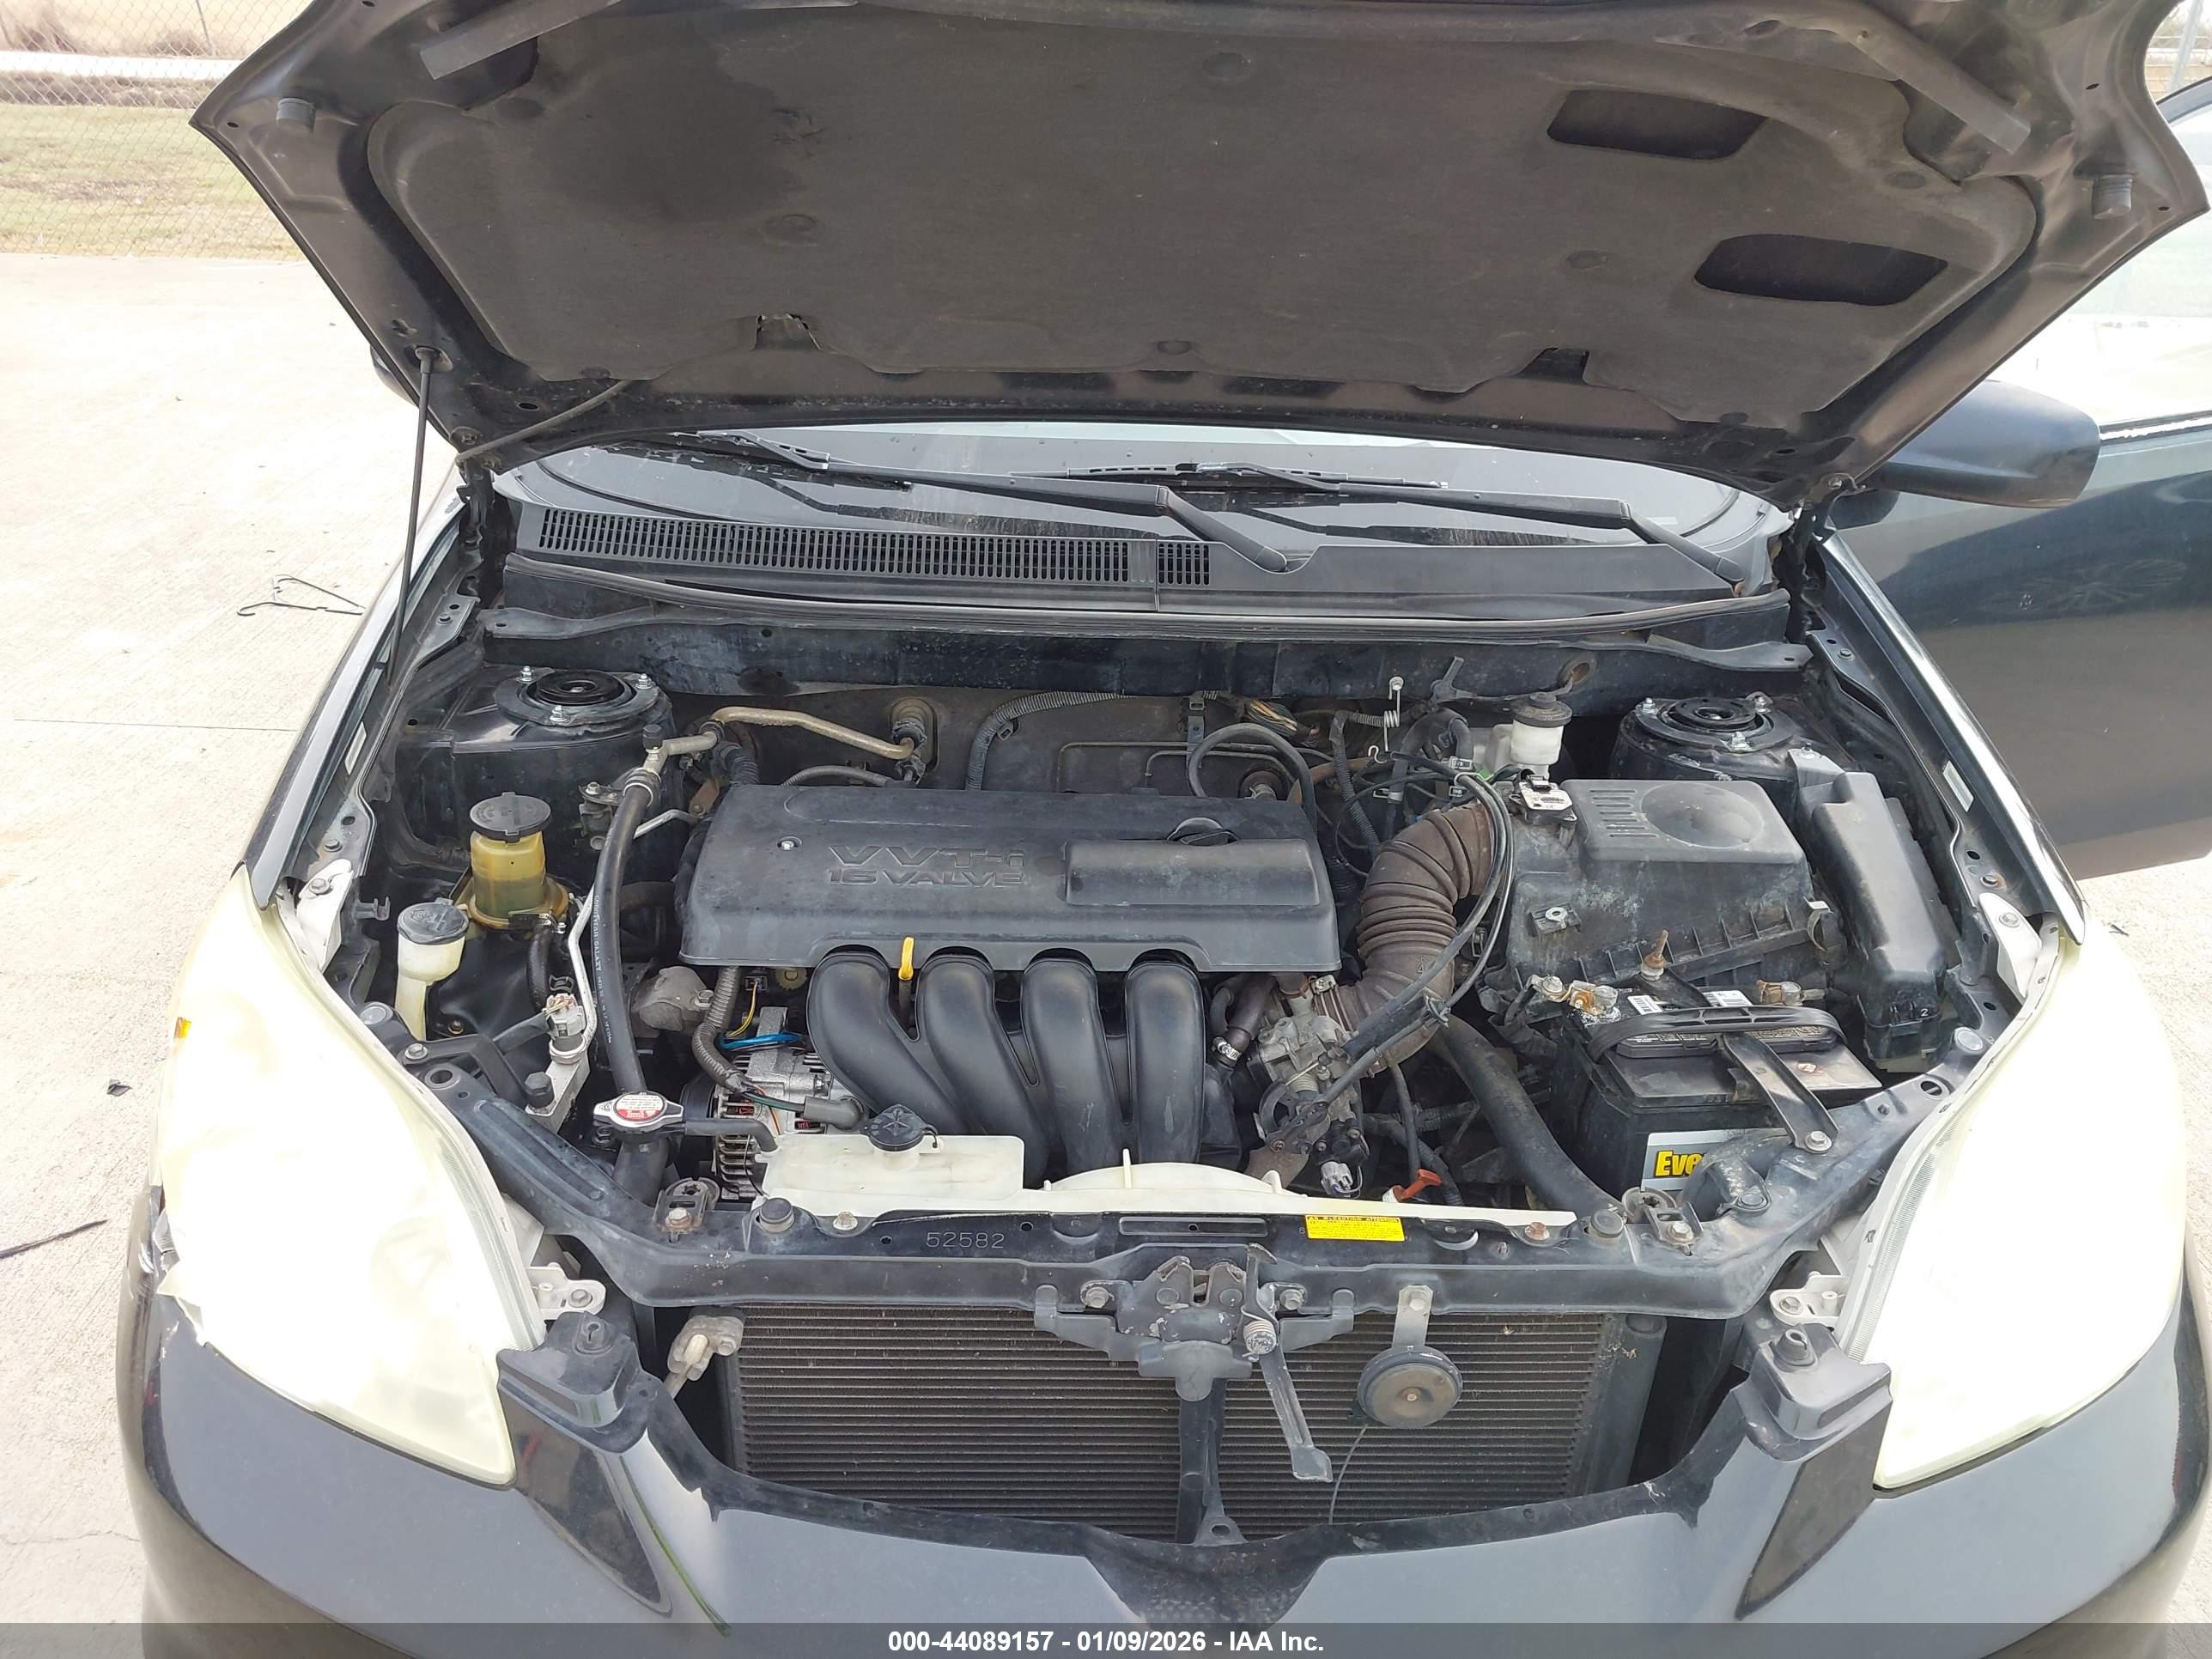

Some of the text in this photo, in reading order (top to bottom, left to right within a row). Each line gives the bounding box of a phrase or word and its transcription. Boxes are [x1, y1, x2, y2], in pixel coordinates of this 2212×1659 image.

[826, 866, 1026, 888] 16 VALVE
[593, 940, 602, 971] GALAXY
[1920, 1008, 1929, 1017] 2
[926, 1231, 1005, 1249] 52582
